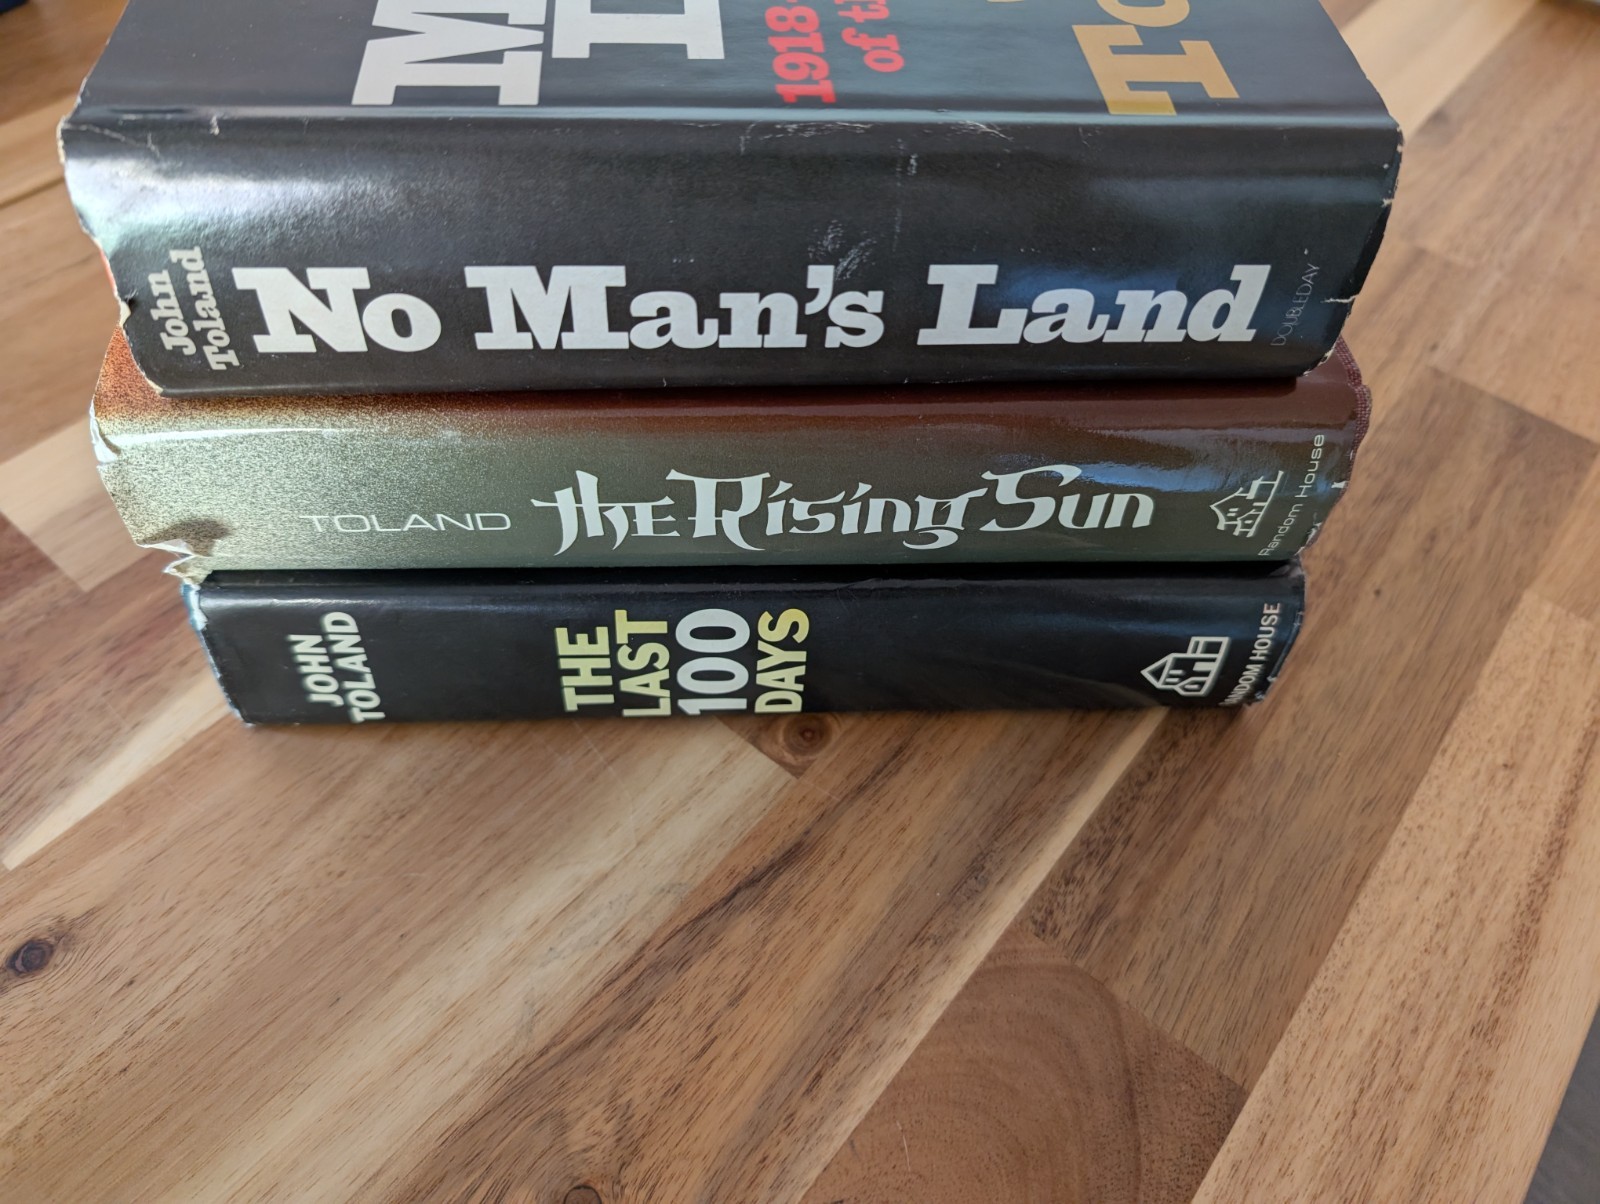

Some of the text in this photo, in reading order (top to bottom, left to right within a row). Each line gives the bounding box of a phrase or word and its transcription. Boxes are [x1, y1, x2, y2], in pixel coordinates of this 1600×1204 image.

[764, 0, 837, 104] 1918
[841, 27, 905, 73] of
[148, 269, 197, 355] John
[170, 246, 240, 370] Toland
[231, 264, 1272, 353] No Man's Land
[1270, 263, 1320, 347] DOUBLEDAY
[300, 512, 512, 533] TOLAND
[665, 469, 989, 551] Rising
[980, 464, 1155, 532] Sun
[1257, 434, 1325, 557] Random House
[286, 634, 344, 707] JOHN
[320, 611, 386, 723] TOLAND
[554, 627, 615, 712] THE
[614, 609, 671, 717] LAST
[675, 608, 750, 715] 100
[754, 608, 810, 714] DAYS
[1249, 602, 1281, 660] HOUSE
